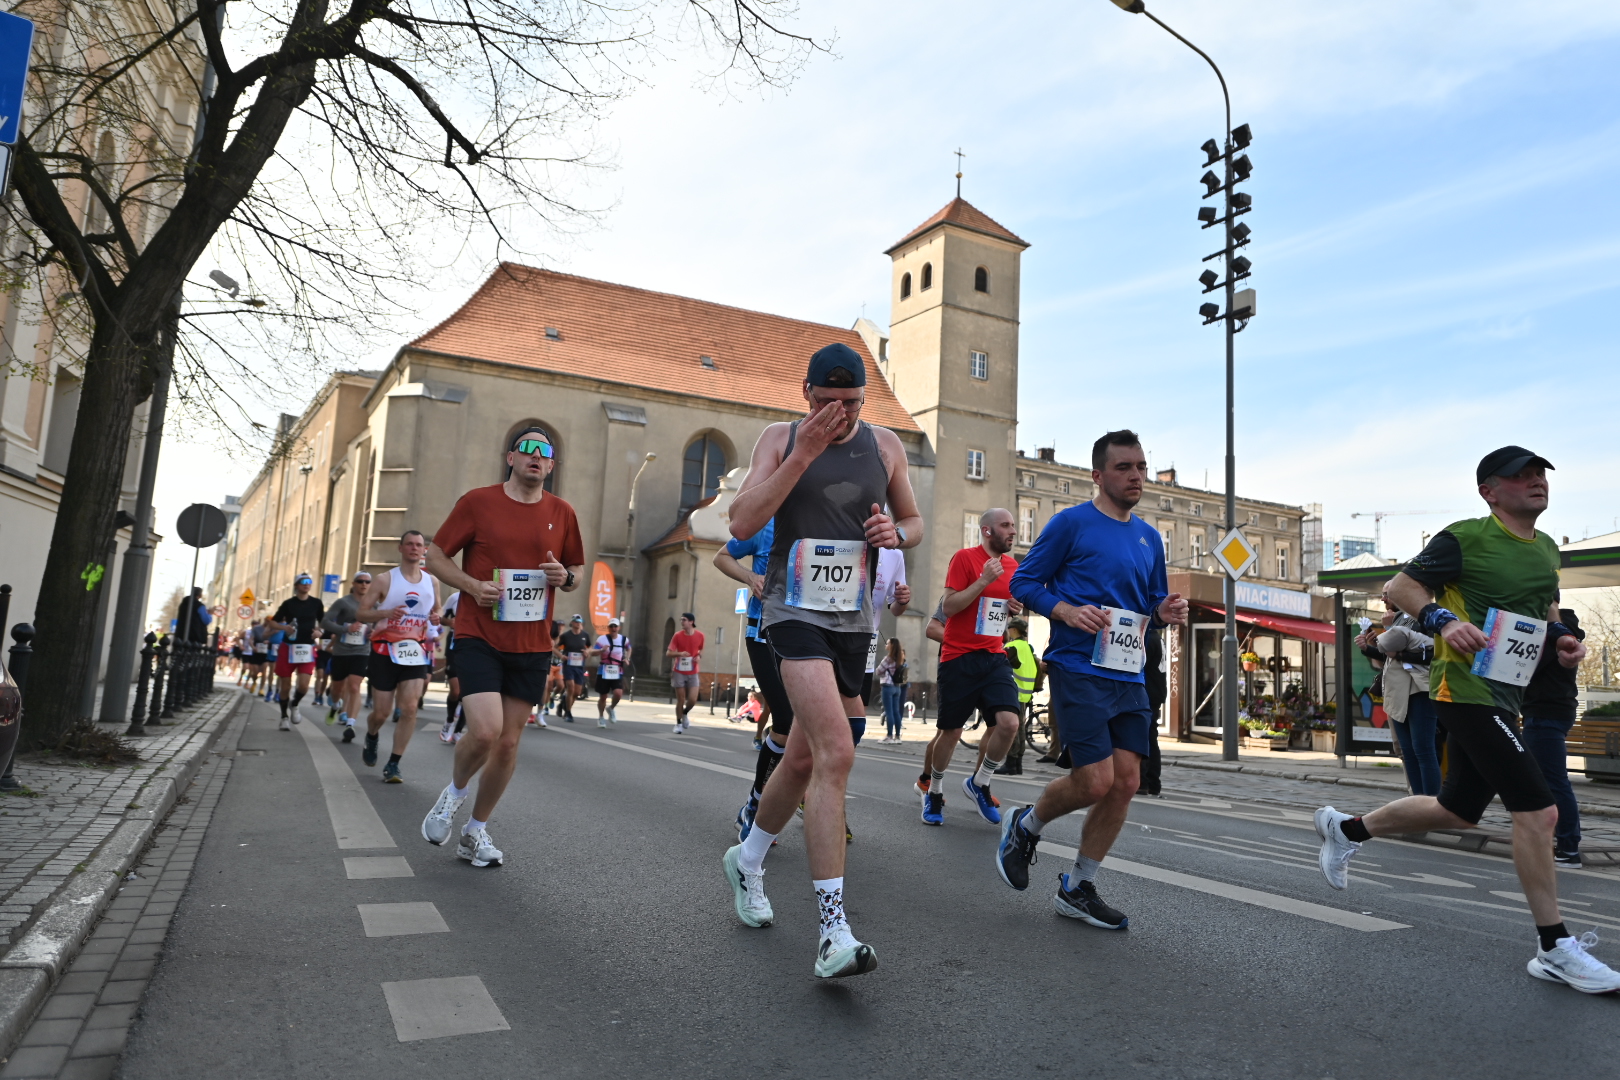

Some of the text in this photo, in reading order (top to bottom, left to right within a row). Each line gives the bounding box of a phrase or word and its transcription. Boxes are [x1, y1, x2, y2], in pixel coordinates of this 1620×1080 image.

[811, 565, 853, 583] 7107
[506, 588, 545, 601] 12877
[1235, 585, 1310, 612] WIACIARNIA
[387, 618, 427, 628] RE/MAX
[398, 649, 419, 659] 2146
[1505, 637, 1540, 661] 7495
[1492, 715, 1525, 753] SALOMON
